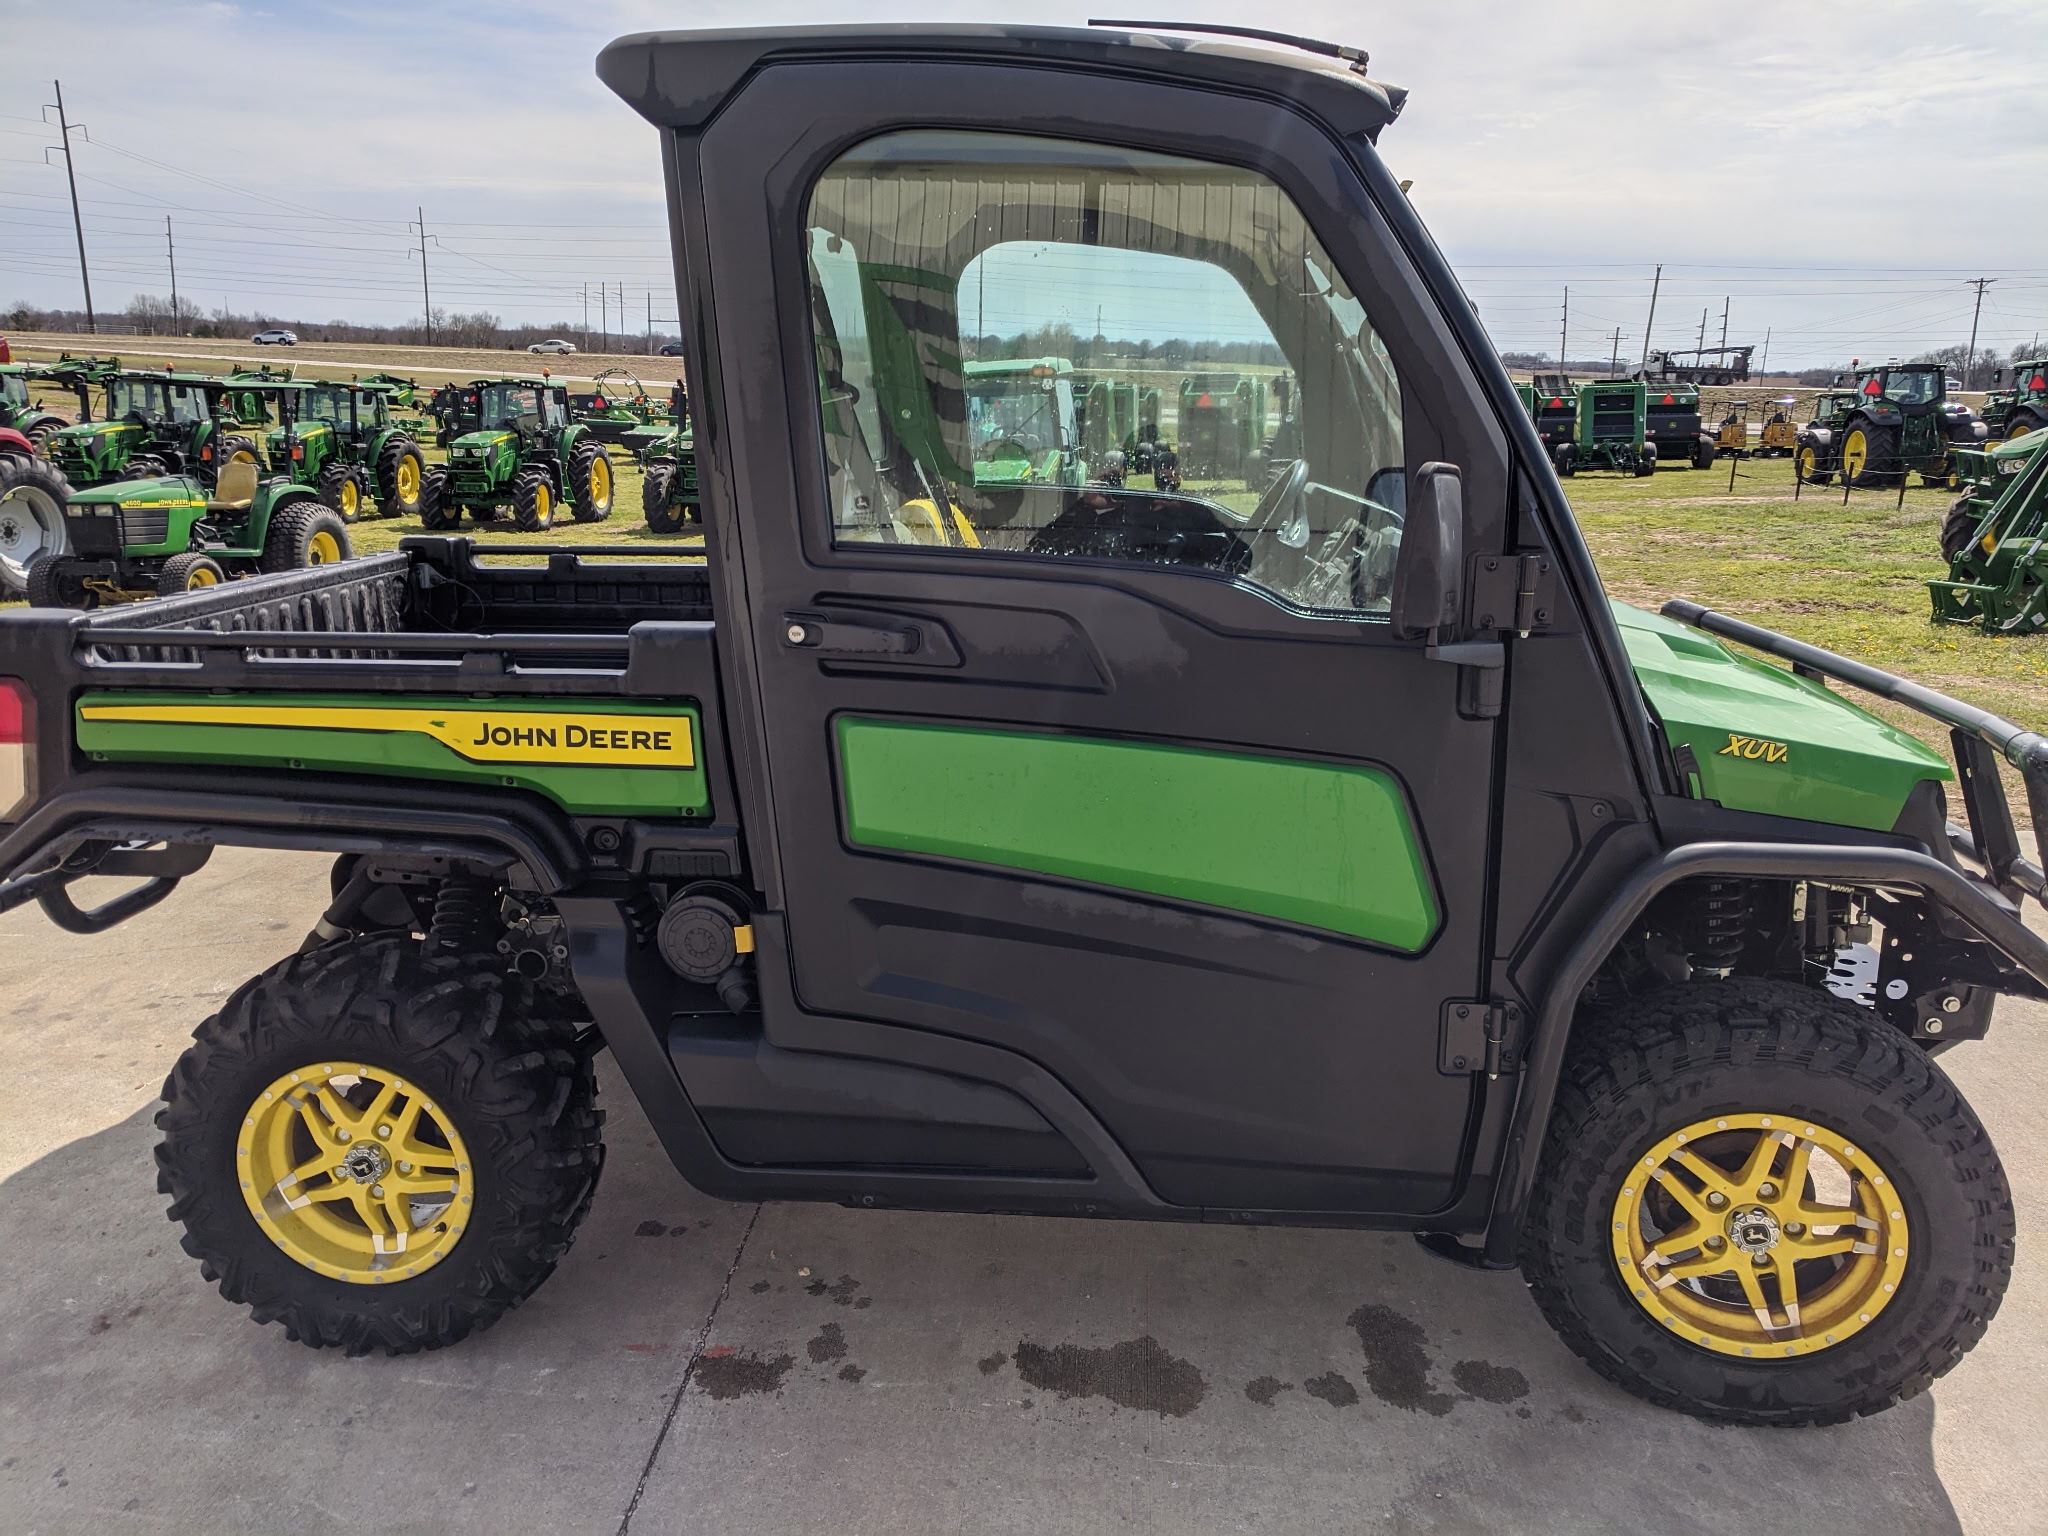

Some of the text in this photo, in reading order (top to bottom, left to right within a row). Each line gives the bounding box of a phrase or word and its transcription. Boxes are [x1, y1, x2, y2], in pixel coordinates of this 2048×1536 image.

[473, 722, 672, 751] JOHN DEERE
[1718, 735, 1788, 763] XUV
